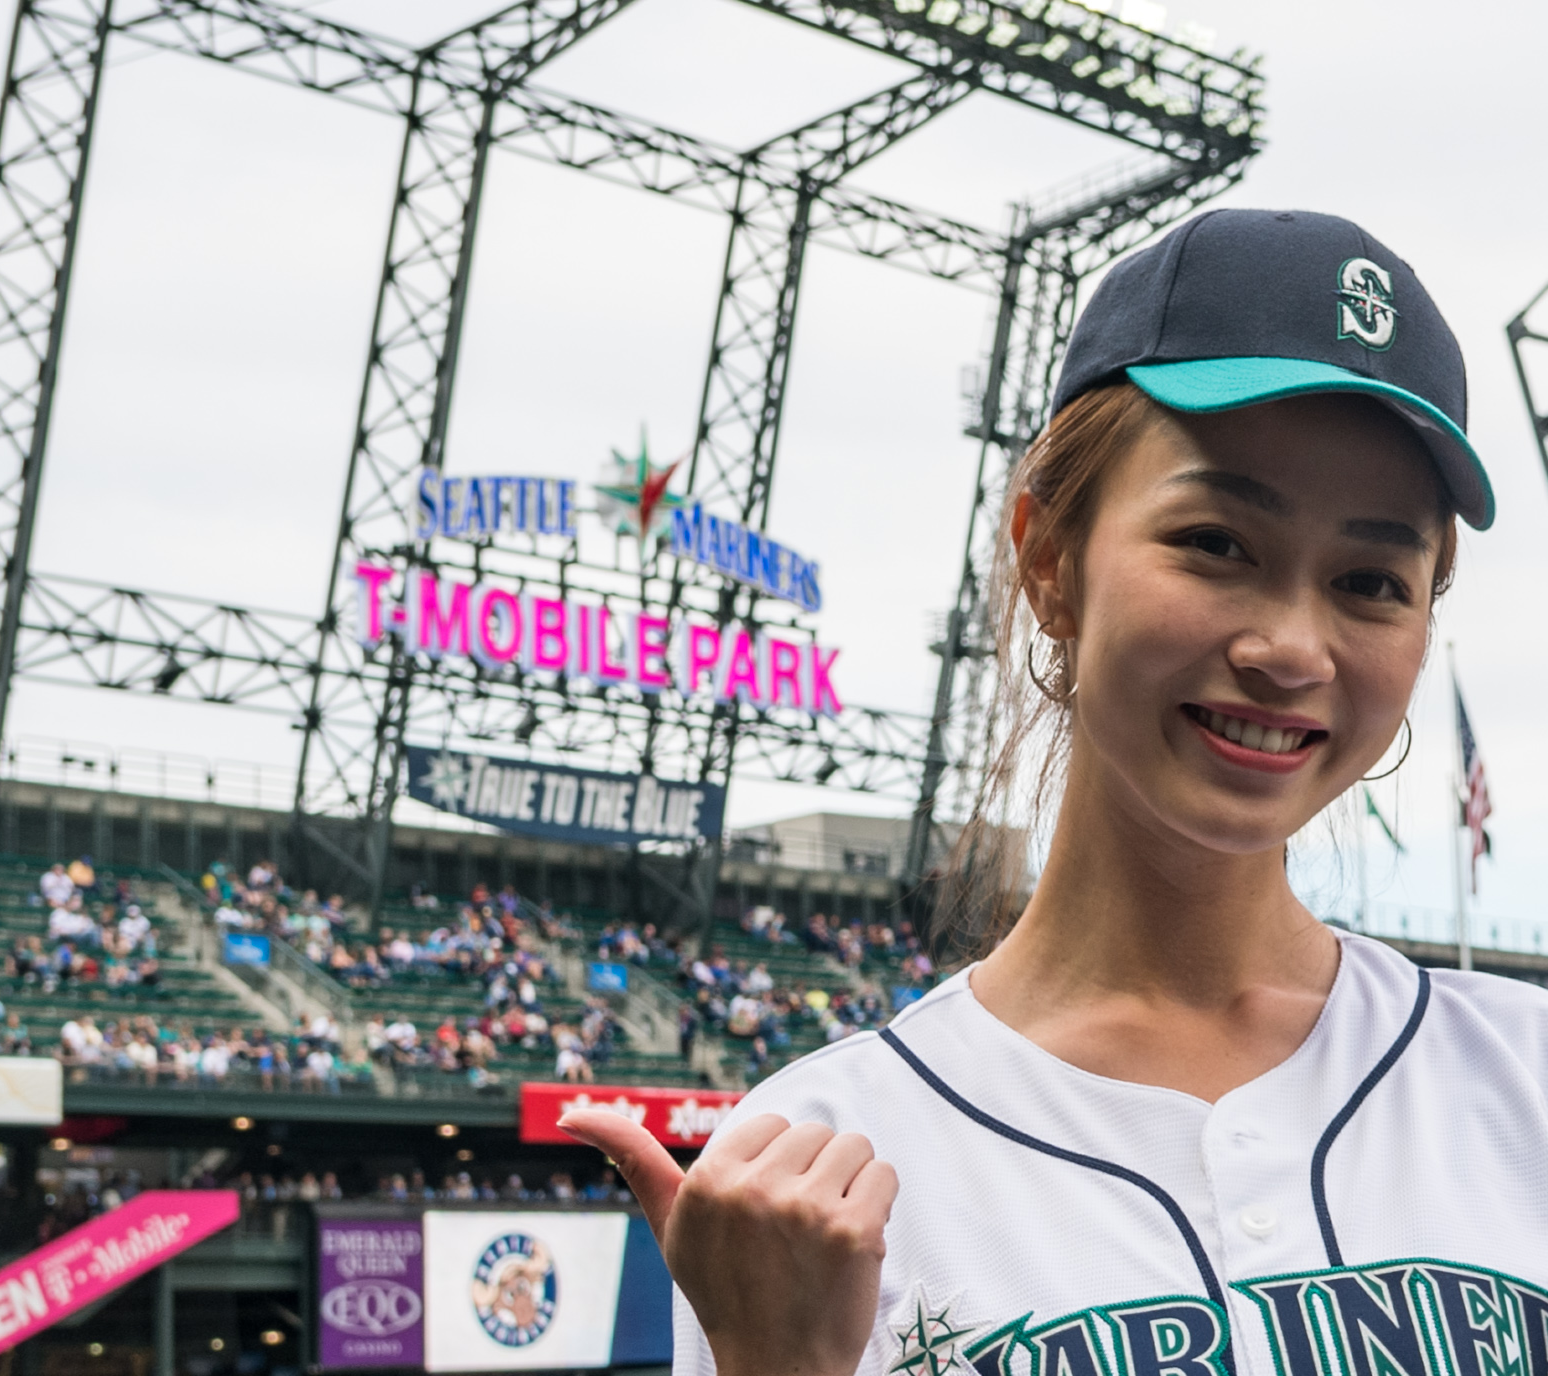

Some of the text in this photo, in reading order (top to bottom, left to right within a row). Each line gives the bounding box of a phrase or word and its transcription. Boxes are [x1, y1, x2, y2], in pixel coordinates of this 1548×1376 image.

[416, 469, 577, 539] SEATTLE
[669, 504, 821, 613] MARINERS
[356, 560, 842, 715] T-MOBILE PARK
[464, 755, 704, 838] TRUE TO THE BLUE
